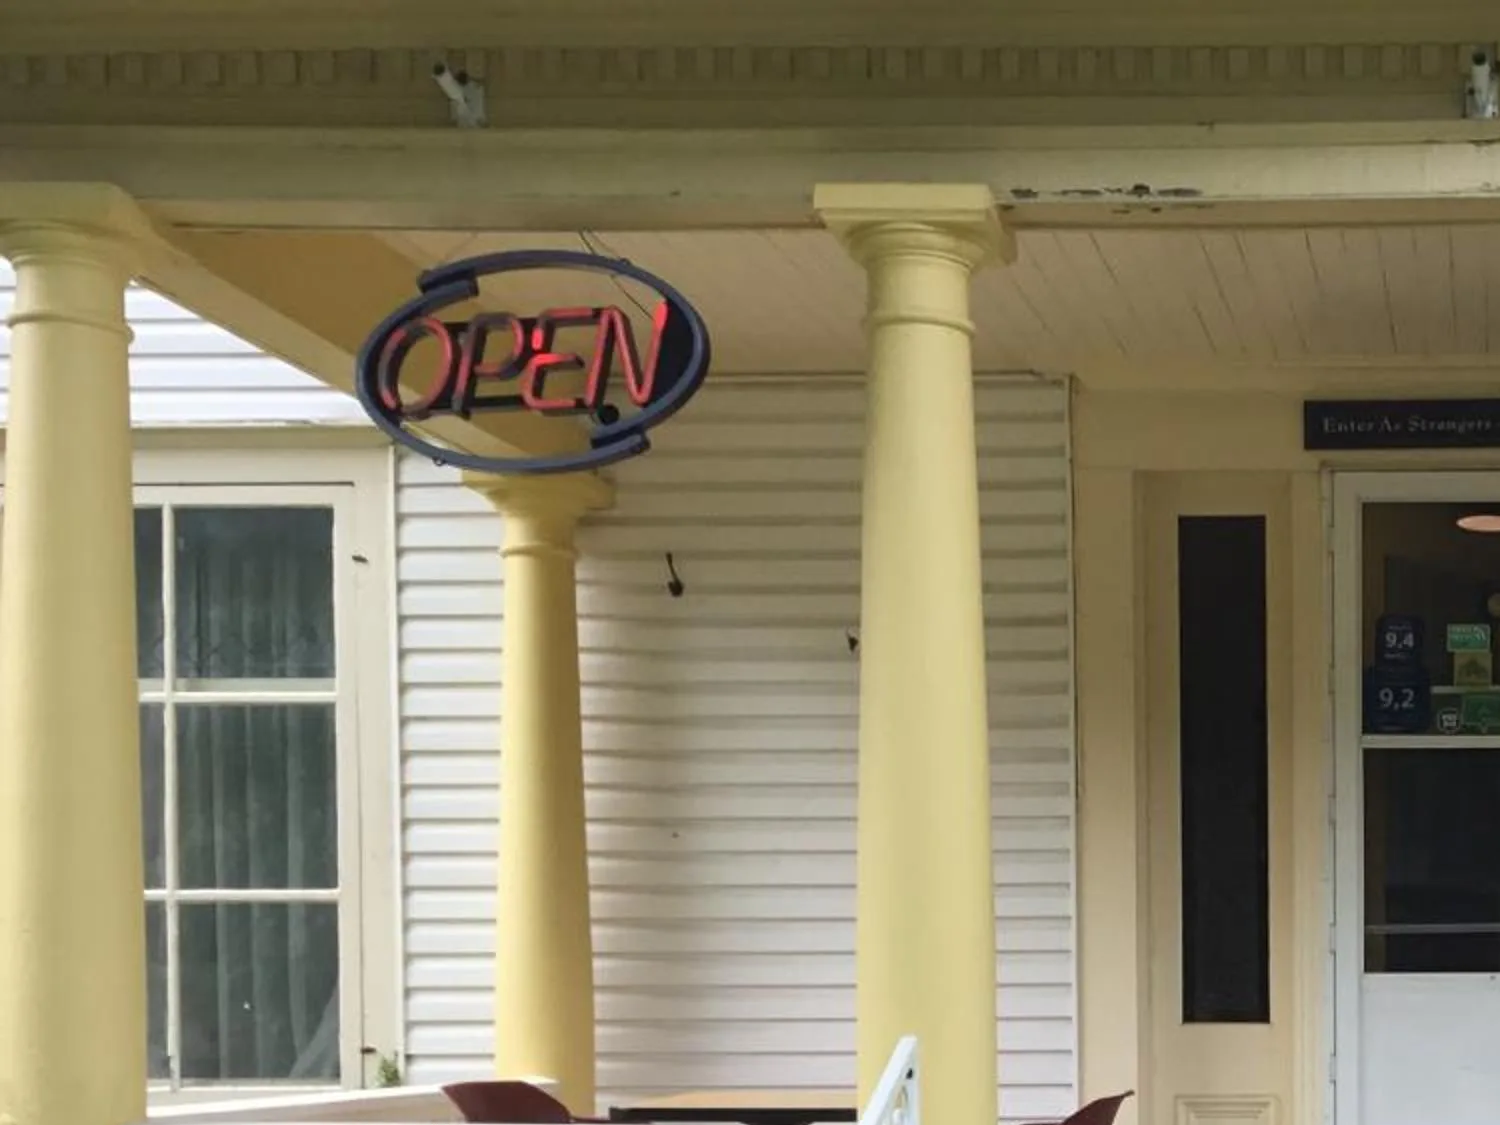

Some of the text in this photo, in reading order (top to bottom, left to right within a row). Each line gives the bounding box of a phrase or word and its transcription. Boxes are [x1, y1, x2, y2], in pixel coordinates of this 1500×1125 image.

[377, 299, 669, 421] OPEN
[1322, 416, 1375, 434] Enter
[1378, 415, 1401, 433] As
[1407, 414, 1492, 435] Strangers
